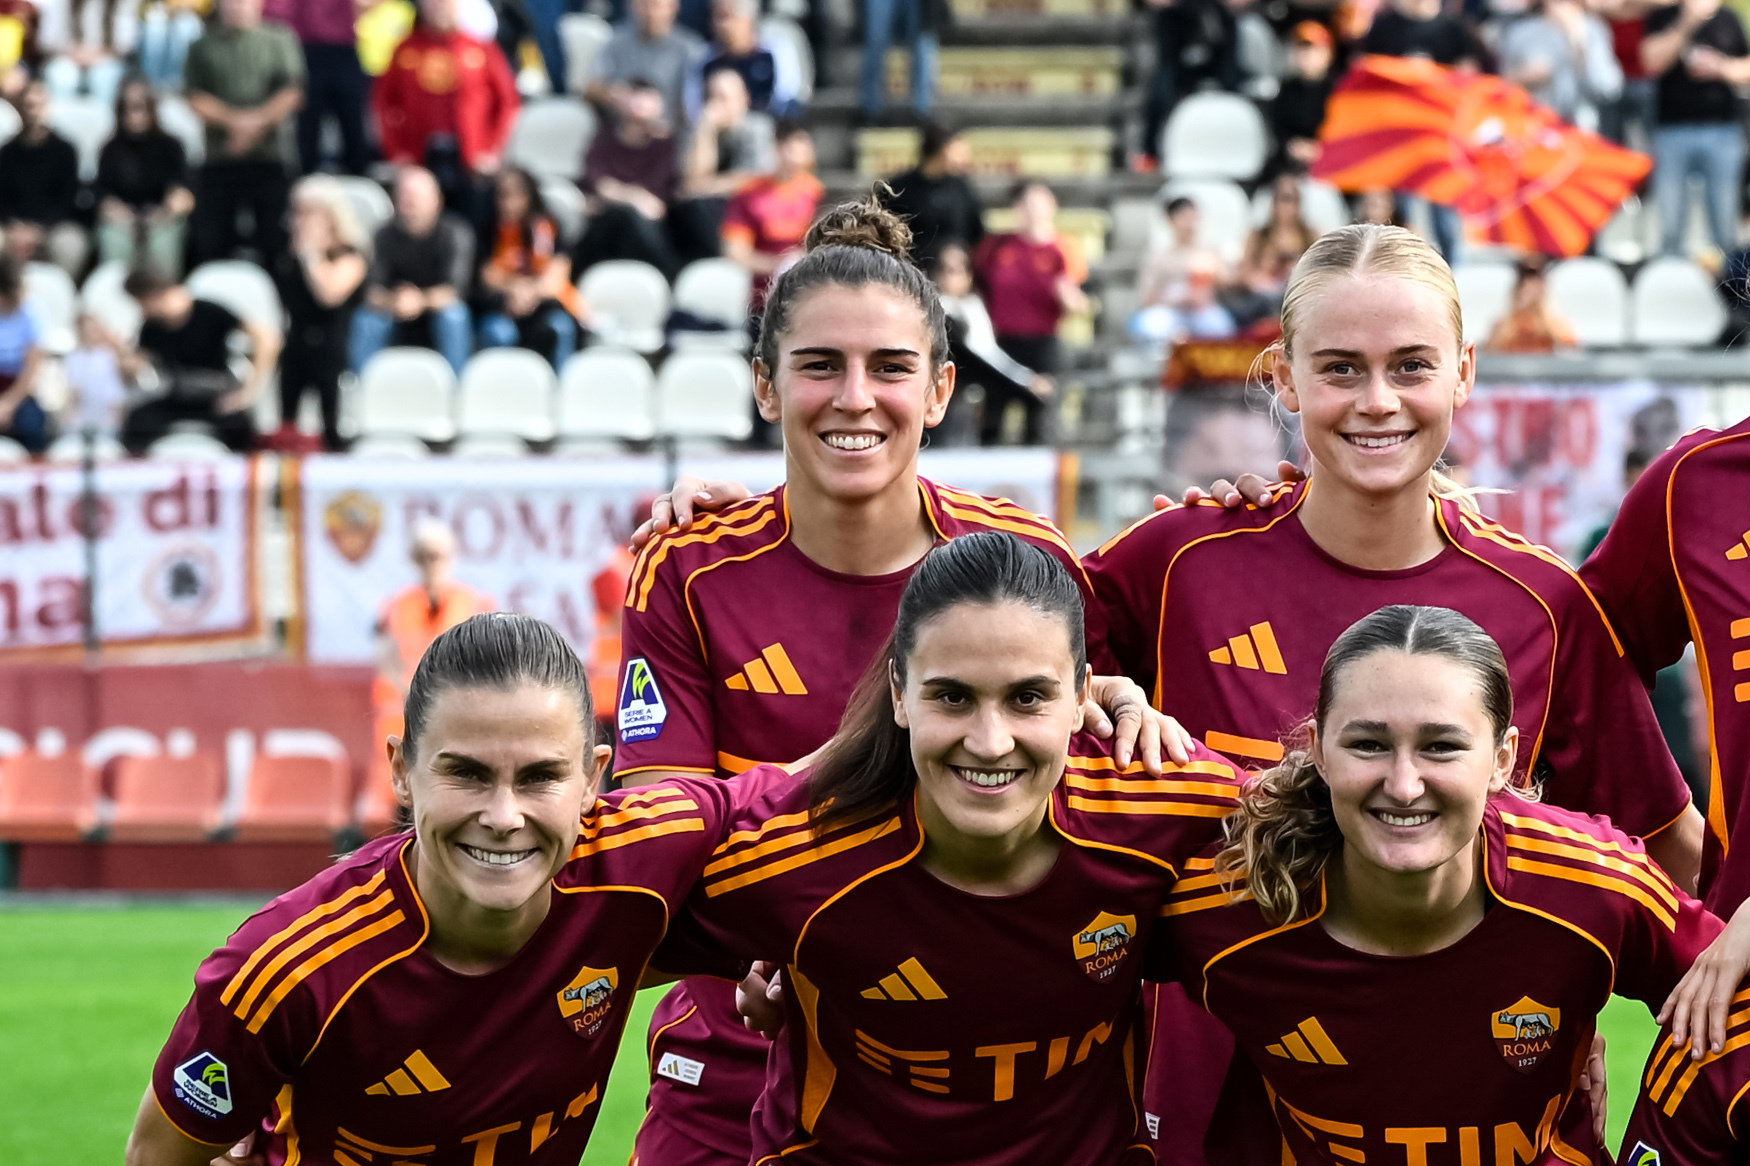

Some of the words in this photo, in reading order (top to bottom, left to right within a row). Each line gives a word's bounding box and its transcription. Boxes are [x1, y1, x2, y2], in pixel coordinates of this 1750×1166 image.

[624, 709, 646, 717] SERIE
[624, 715, 653, 723] WOMEN
[627, 726, 657, 738] ATHORA
[1085, 947, 1128, 974] ROMA
[573, 1001, 611, 1032] ROMA
[1502, 1040, 1551, 1057] ROMA
[1518, 1056, 1537, 1067] 1927
[184, 1097, 217, 1119] ATHORA
